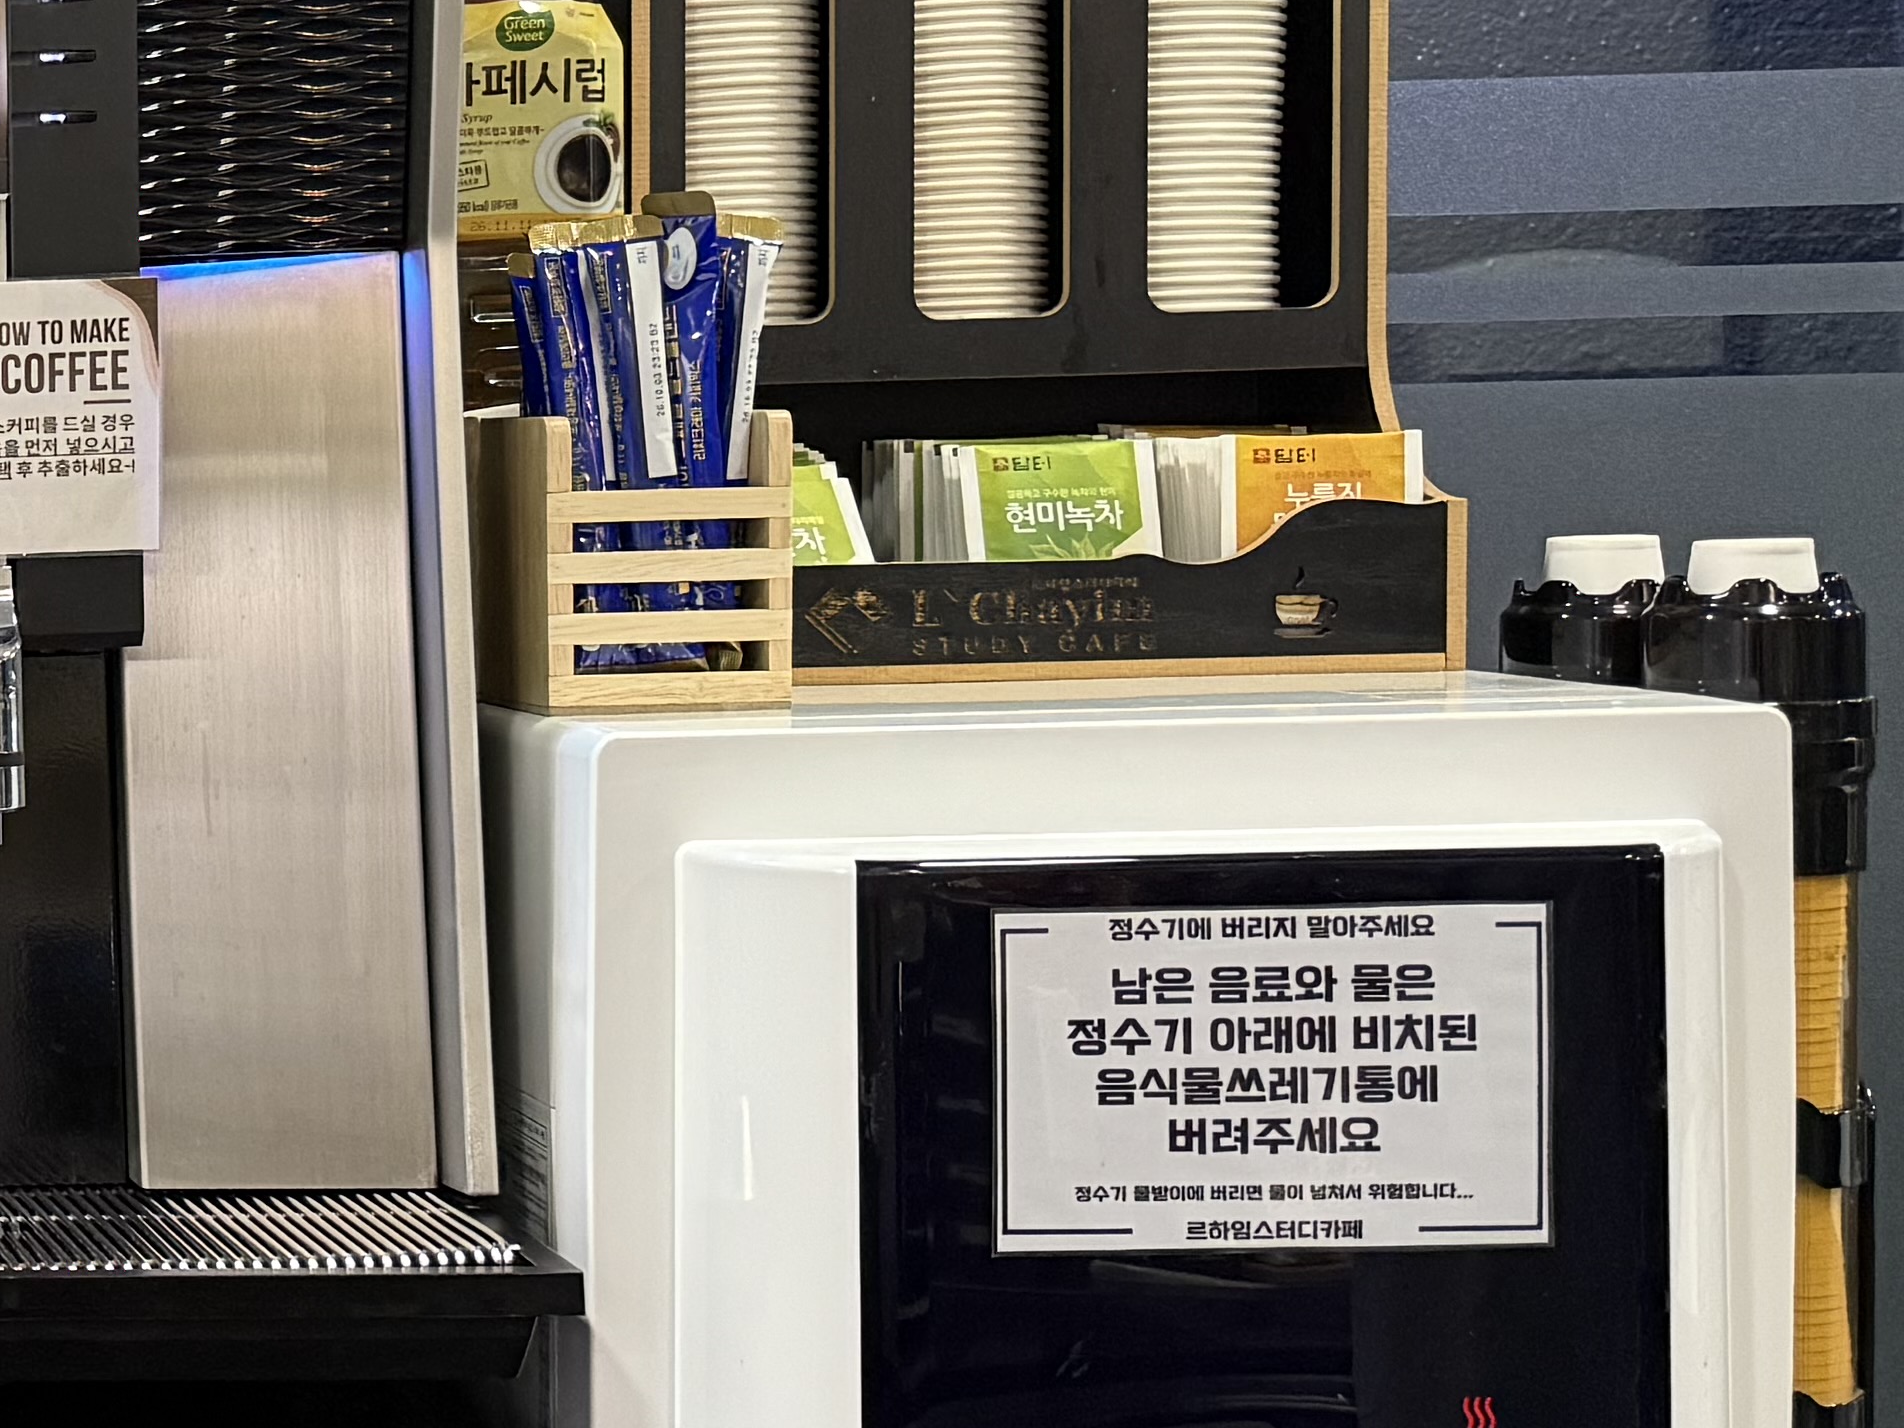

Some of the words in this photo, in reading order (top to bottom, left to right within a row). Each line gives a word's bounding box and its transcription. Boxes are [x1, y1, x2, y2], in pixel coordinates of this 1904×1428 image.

[503, 15, 546, 31] Green
[505, 30, 544, 43] Sweet
[36, 319, 64, 346] TO
[70, 317, 131, 346] MAKE
[0, 349, 131, 395] COFFEE
[62, 415, 96, 433] 드실
[101, 413, 135, 433] 경우
[25, 437, 58, 457] 먼저
[66, 435, 135, 455] 넣으시고
[16, 461, 33, 478] 후
[1004, 500, 1124, 533] 현미녹차
[912, 635, 1032, 655] STUDY
[1058, 633, 1157, 653] CAFE
[1108, 916, 1212, 942] 정수기에
[1220, 914, 1297, 940] 버리지
[1306, 913, 1436, 939] 말아주세요
[1111, 967, 1195, 1006] 남은
[1208, 965, 1338, 1005] 음료와
[1351, 962, 1437, 1002] 물은
[1067, 1016, 1193, 1056] 정수기
[1209, 1014, 1338, 1054] 아래에
[1352, 1012, 1479, 1053] 비치된
[1094, 1064, 1440, 1106] 음식물쓰레기통에
[1168, 1116, 1382, 1156] 버려주세요
[1074, 1184, 1126, 1203] 정수기
[1133, 1184, 1205, 1203] 물받이에
[1209, 1184, 1264, 1202] 버리면
[1186, 1219, 1364, 1241] 르하임스터디카페
